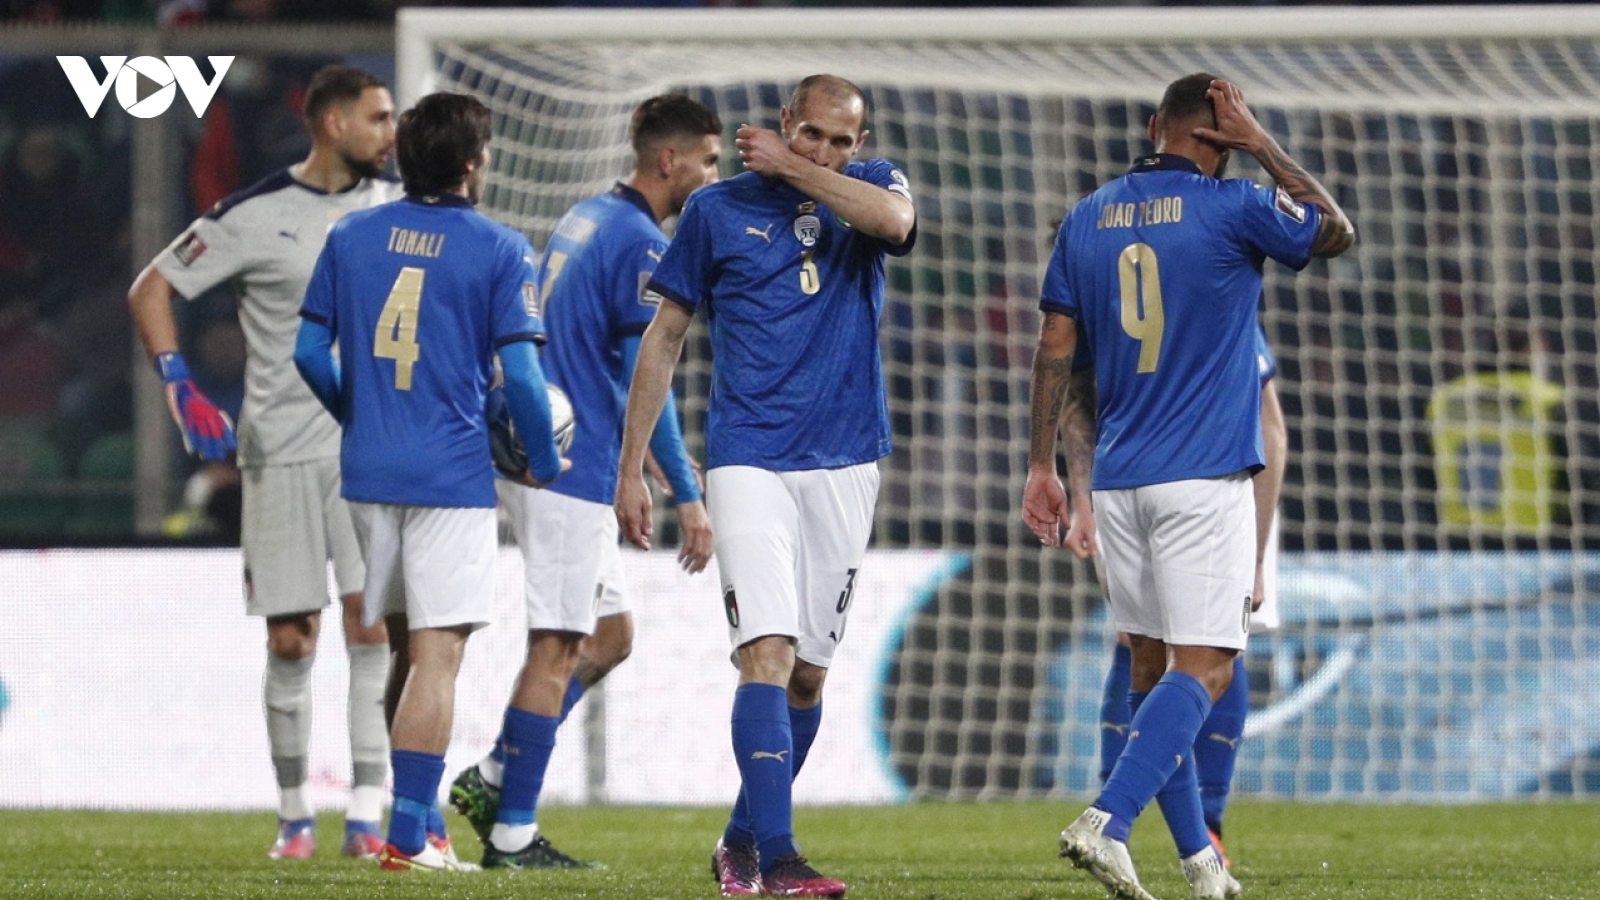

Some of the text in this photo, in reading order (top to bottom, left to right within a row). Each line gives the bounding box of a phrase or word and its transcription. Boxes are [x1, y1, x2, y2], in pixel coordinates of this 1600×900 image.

[1097, 196, 1183, 230] JOAO PEDRO
[387, 226, 446, 258] TONALI
[799, 250, 821, 296] 3
[373, 266, 426, 391] 4
[1118, 242, 1165, 374] 9
[835, 568, 858, 614] 3
